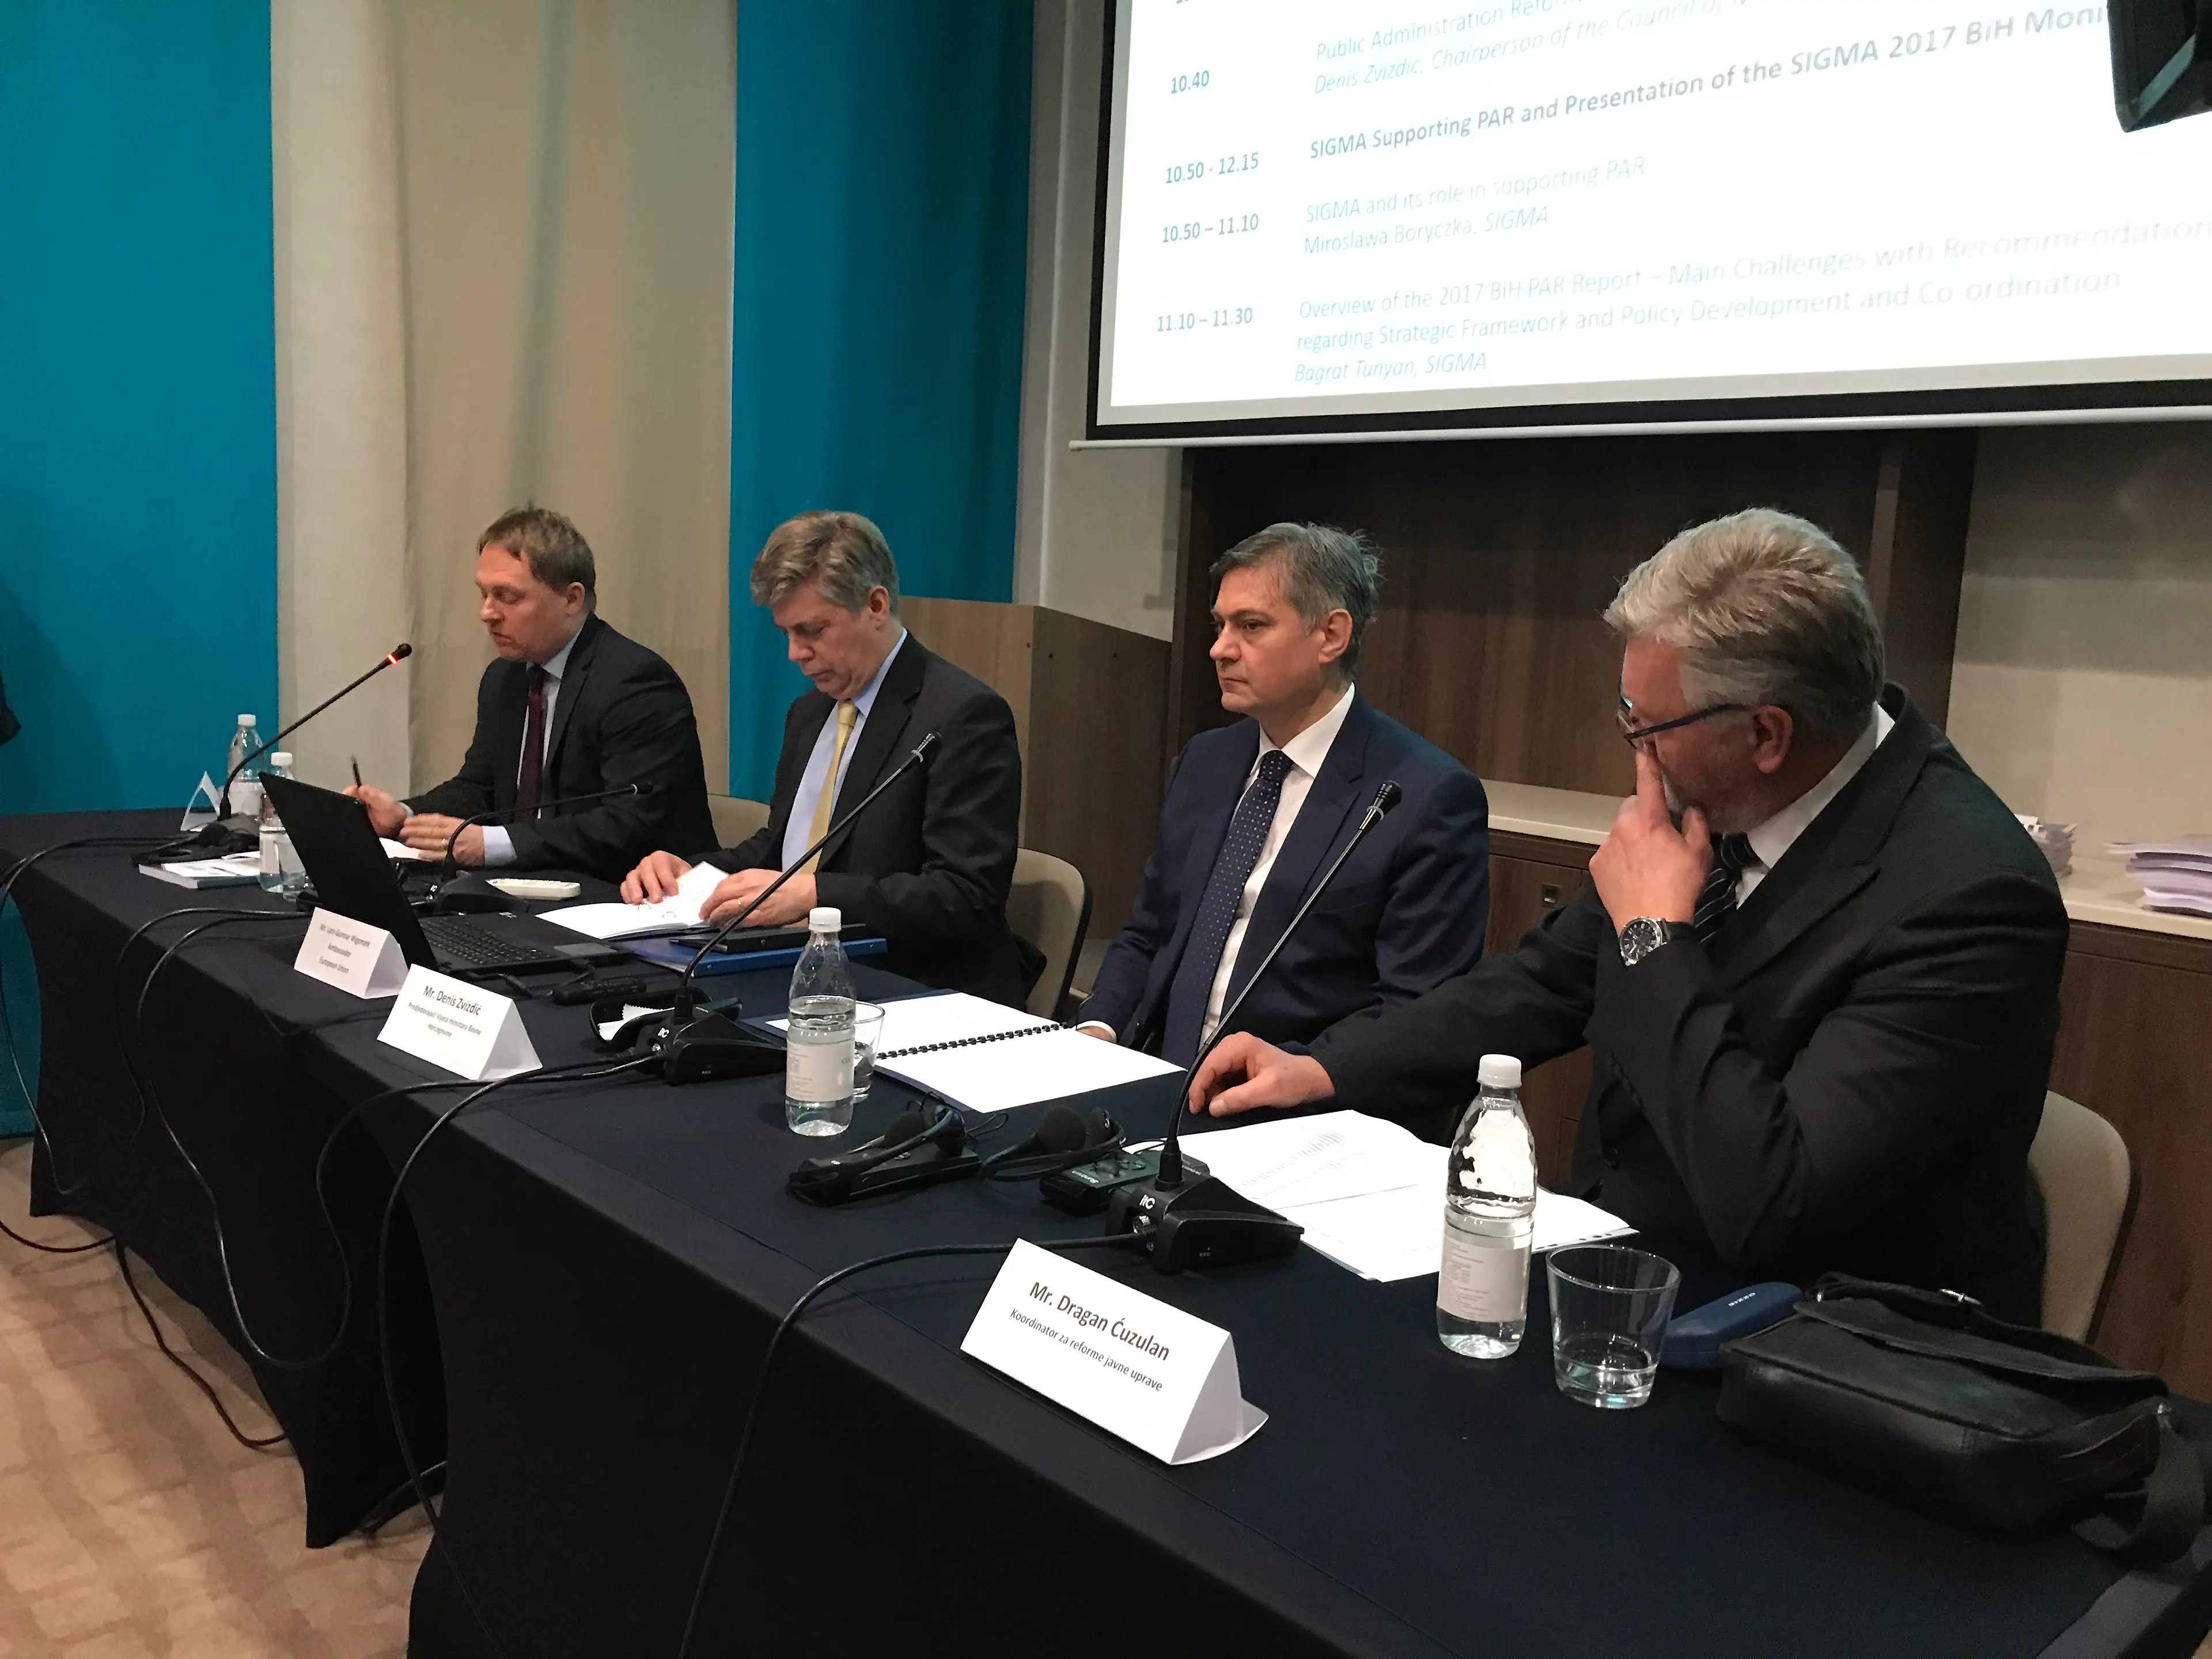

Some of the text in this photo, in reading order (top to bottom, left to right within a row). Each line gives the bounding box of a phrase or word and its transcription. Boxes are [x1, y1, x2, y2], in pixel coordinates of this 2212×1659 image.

[1315, 71, 1358, 94] Denis
[1433, 34, 1543, 70] Chairperson
[1551, 26, 1569, 48] of
[1577, 15, 1609, 43] the
[1317, 35, 1365, 60] Public
[1371, 6, 1503, 50] Administration
[1171, 70, 1210, 94] 10.40
[1310, 132, 1367, 159] SIGMA
[1373, 117, 1471, 148] Supporting
[1478, 107, 1514, 130] PAR
[1521, 98, 1558, 123] and
[1565, 73, 1703, 115] Presentation
[1711, 65, 1736, 89] of
[1744, 55, 1781, 82] the
[1791, 40, 1878, 75] SIGMA
[1888, 25, 1956, 59] 2017
[1966, 16, 2014, 46] BiH
[1165, 161, 1204, 184] 10.50
[1218, 151, 1259, 175] 12.15
[1306, 156, 1646, 224] SIGMA and its role in supporting PAR
[1162, 221, 1200, 243] 10.50
[1218, 213, 1259, 235] 11.10
[1305, 229, 1388, 255] Miroslawa
[1484, 206, 1548, 233] SIGMA
[1300, 298, 1376, 319] Overview
[1381, 290, 1399, 312] of
[1405, 287, 1433, 310] the
[1440, 283, 1484, 306] 2017
[1491, 281, 1521, 302] BiH
[1529, 275, 1564, 298] PAR
[1573, 270, 1641, 297] Report
[1669, 262, 1725, 285] Main
[1734, 251, 1865, 280] Challenges
[1875, 241, 1932, 266] with
[1157, 313, 1195, 332] 11.10
[1213, 307, 1253, 328] 11.30
[1297, 329, 1374, 354] regarding
[1379, 318, 1455, 347] Strategic
[1462, 310, 1567, 339] Framework
[1577, 307, 1613, 329] and
[1622, 302, 1682, 327] Policy
[1691, 291, 1850, 323] Development
[1861, 284, 1910, 309] and
[1295, 359, 1348, 385] Bagrat
[1425, 352, 1486, 373] SIGMA
[423, 986, 482, 1015] Mr. Denis Zvizdić
[1029, 1281, 1169, 1361] Mr. Dragan Ćuzulan
[1010, 1308, 1162, 1392] Koordinator za reforme javne uprave
